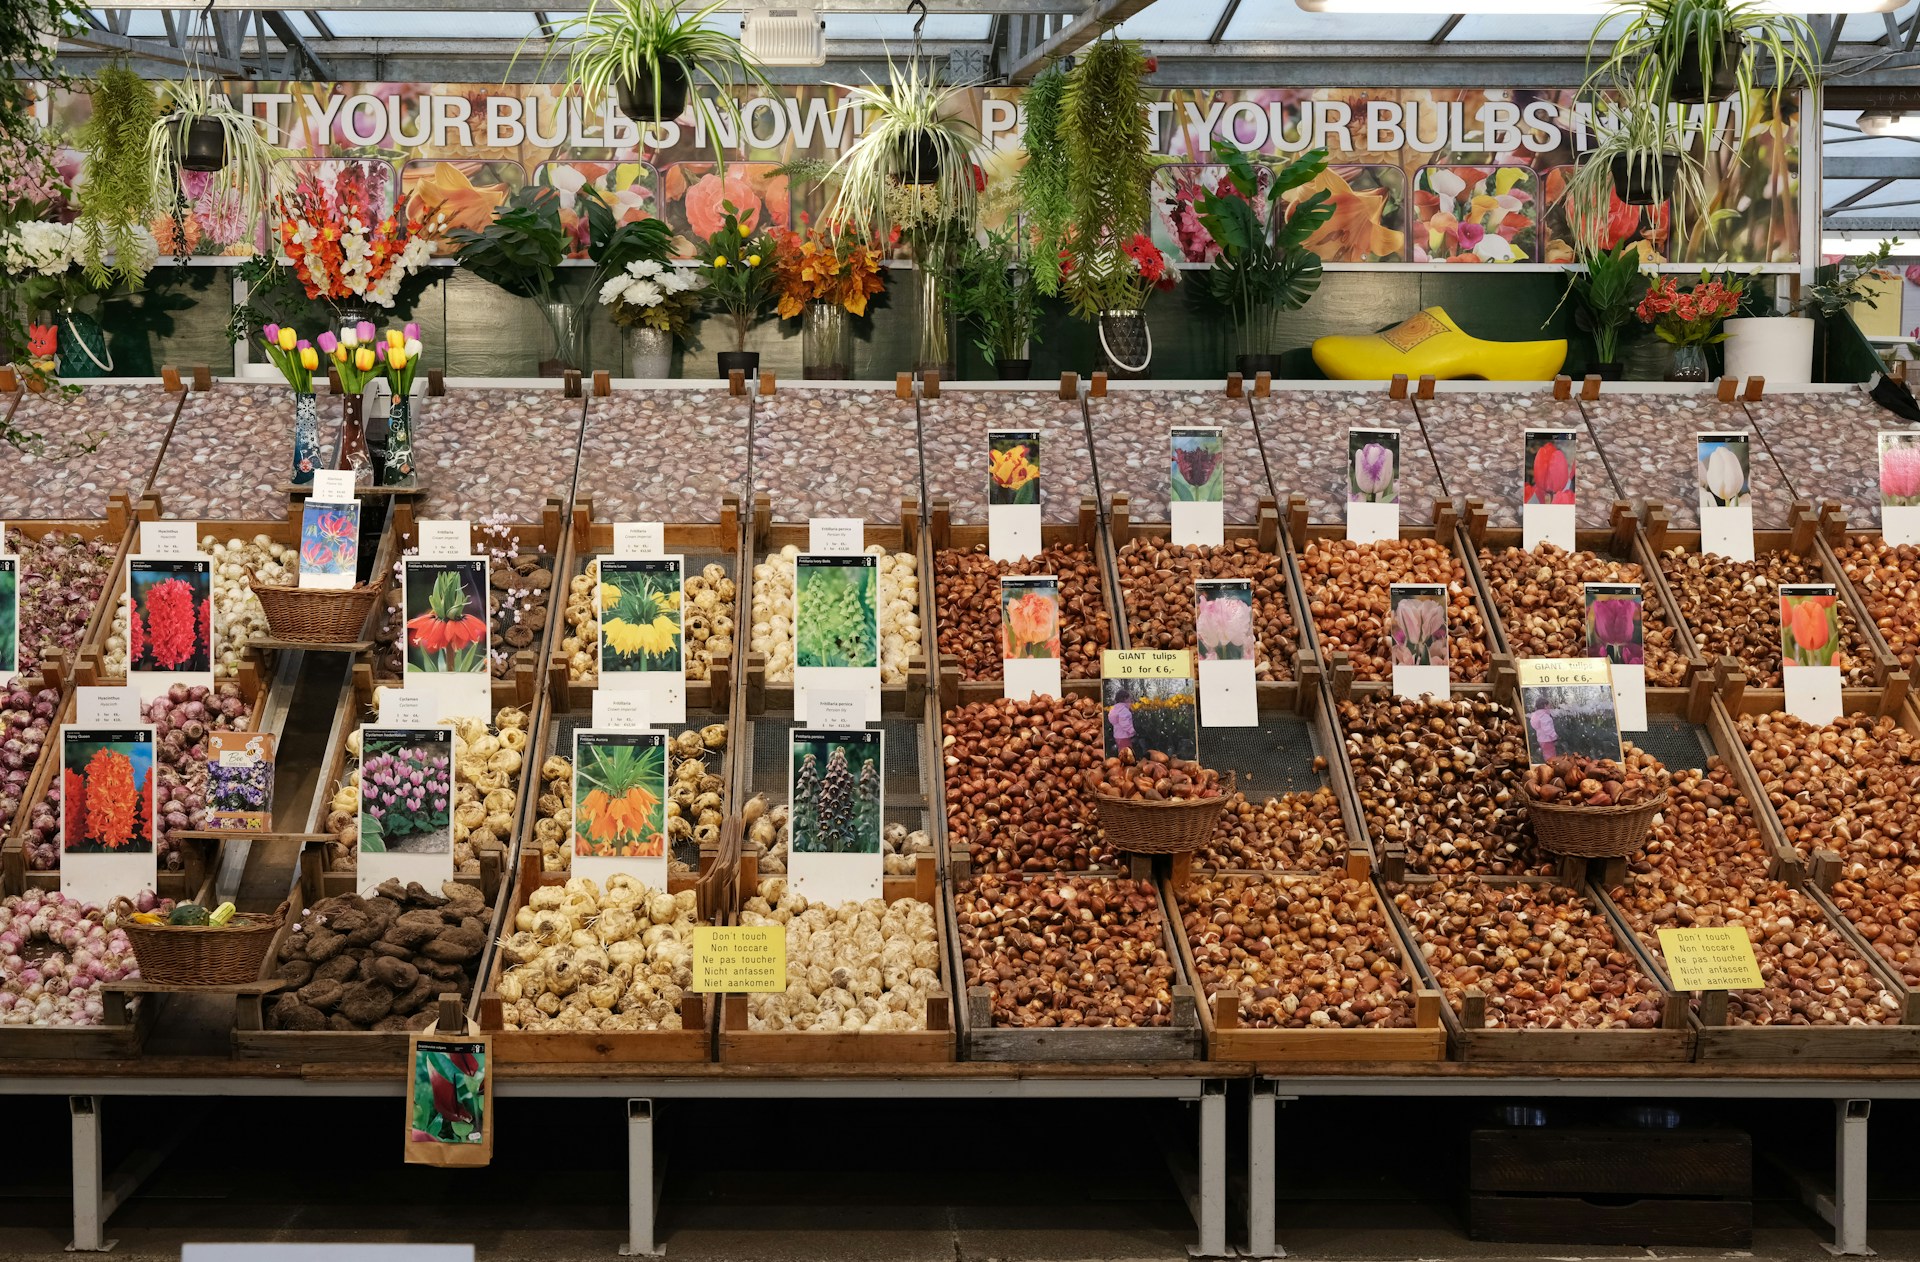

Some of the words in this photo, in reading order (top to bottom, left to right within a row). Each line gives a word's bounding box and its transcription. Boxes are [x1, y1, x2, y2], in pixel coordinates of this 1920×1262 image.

[302, 94, 473, 147] YOUR
[1184, 101, 1353, 152] YOUR
[1367, 101, 1561, 152] BULBS
[1153, 653, 1177, 661] tulips
[1535, 662, 1562, 670] GIANT
[1569, 662, 1593, 670] tulips
[228, 752, 243, 762] Bee
[713, 932, 736, 940] Don't
[742, 932, 766, 940] touch
[1677, 933, 1701, 942] Don't
[1706, 933, 1731, 941] touch
[711, 944, 728, 952] Non
[734, 944, 768, 952] toccare
[1680, 945, 1697, 953] Non
[1702, 944, 1735, 952] toccare
[703, 956, 714, 964] Ne
[720, 957, 736, 965] pas
[742, 956, 776, 964] toucher
[1674, 956, 1687, 964] Ne
[1713, 955, 1746, 963] toucher
[704, 967, 728, 975] Nicht
[734, 967, 775, 975] anfassen
[1680, 967, 1703, 975] Nicht
[1709, 966, 1749, 974] anfassen
[704, 979, 722, 987] Niet
[728, 979, 775, 987] aankomen
[1683, 978, 1702, 986] Niet
[1707, 977, 1753, 985] aankomen
